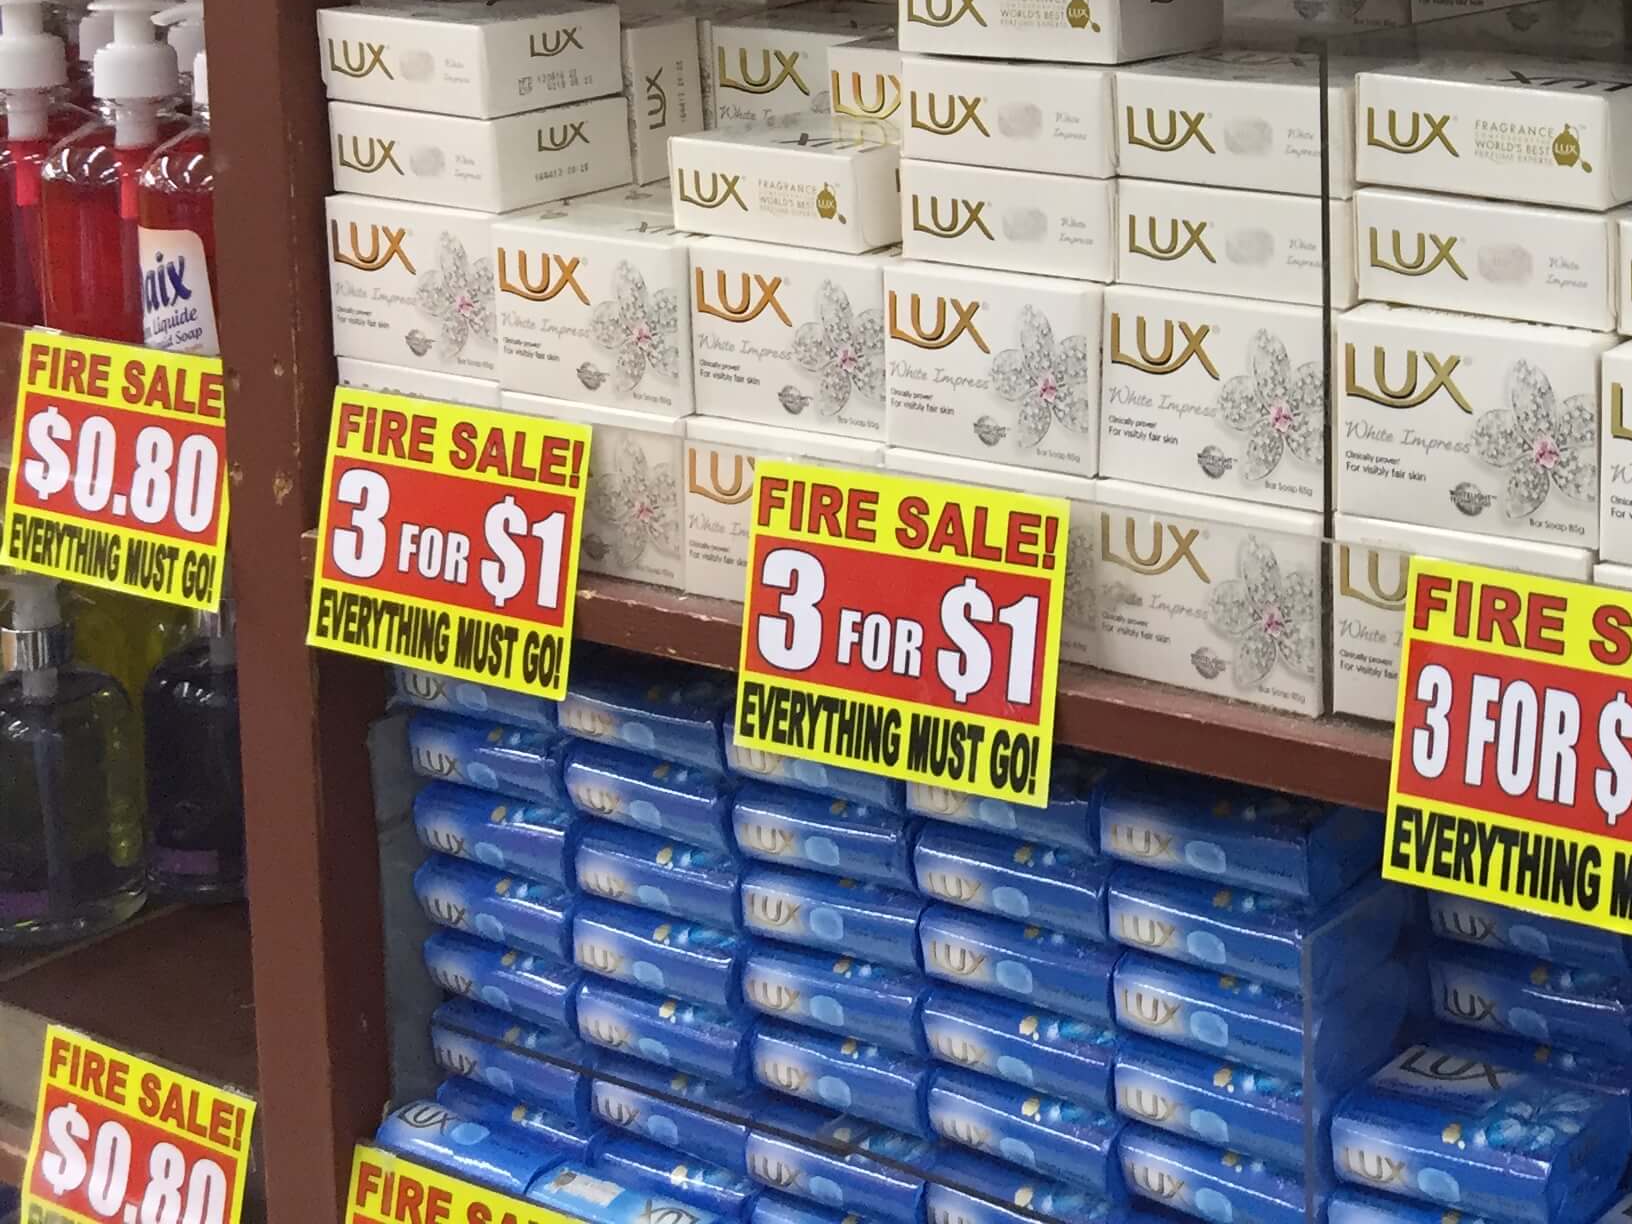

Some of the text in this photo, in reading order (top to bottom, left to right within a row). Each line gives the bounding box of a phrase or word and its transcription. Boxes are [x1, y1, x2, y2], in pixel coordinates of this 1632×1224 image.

[327, 37, 395, 81] LUX
[529, 26, 585, 58] LUX
[645, 66, 668, 131] LUX
[1366, 107, 1460, 159] LUX
[1474, 119, 1554, 139] FRAGRANCE
[143, 251, 193, 314] aix
[153, 307, 198, 336] Liquide
[694, 266, 793, 328] LUX
[176, 327, 203, 345] Soap
[28, 343, 225, 420] FIRE SALE
[24, 406, 219, 534] $0.80
[336, 402, 585, 489] FIRE SALE!
[9, 513, 216, 605] EVERYTHING MUST GO!
[332, 467, 566, 609] 3 FOR $1
[758, 475, 1059, 570] FIRE SALE!
[316, 587, 564, 690] EVERYTHING MUST GO!
[757, 547, 1041, 706] 3 FOR $1
[1412, 572, 1568, 656] FIRE
[739, 681, 1041, 796] EVERYTHING MUST GO!
[1411, 663, 1453, 779] 3
[1464, 673, 1581, 807] FOR
[1109, 822, 1175, 859] LUX
[1390, 804, 1601, 911] EVERYTHING
[1121, 991, 1180, 1026] LUX
[48, 1039, 246, 1150] FIRE SALE!
[41, 1101, 228, 1224] $0.80
[1341, 1145, 1410, 1184] LUX
